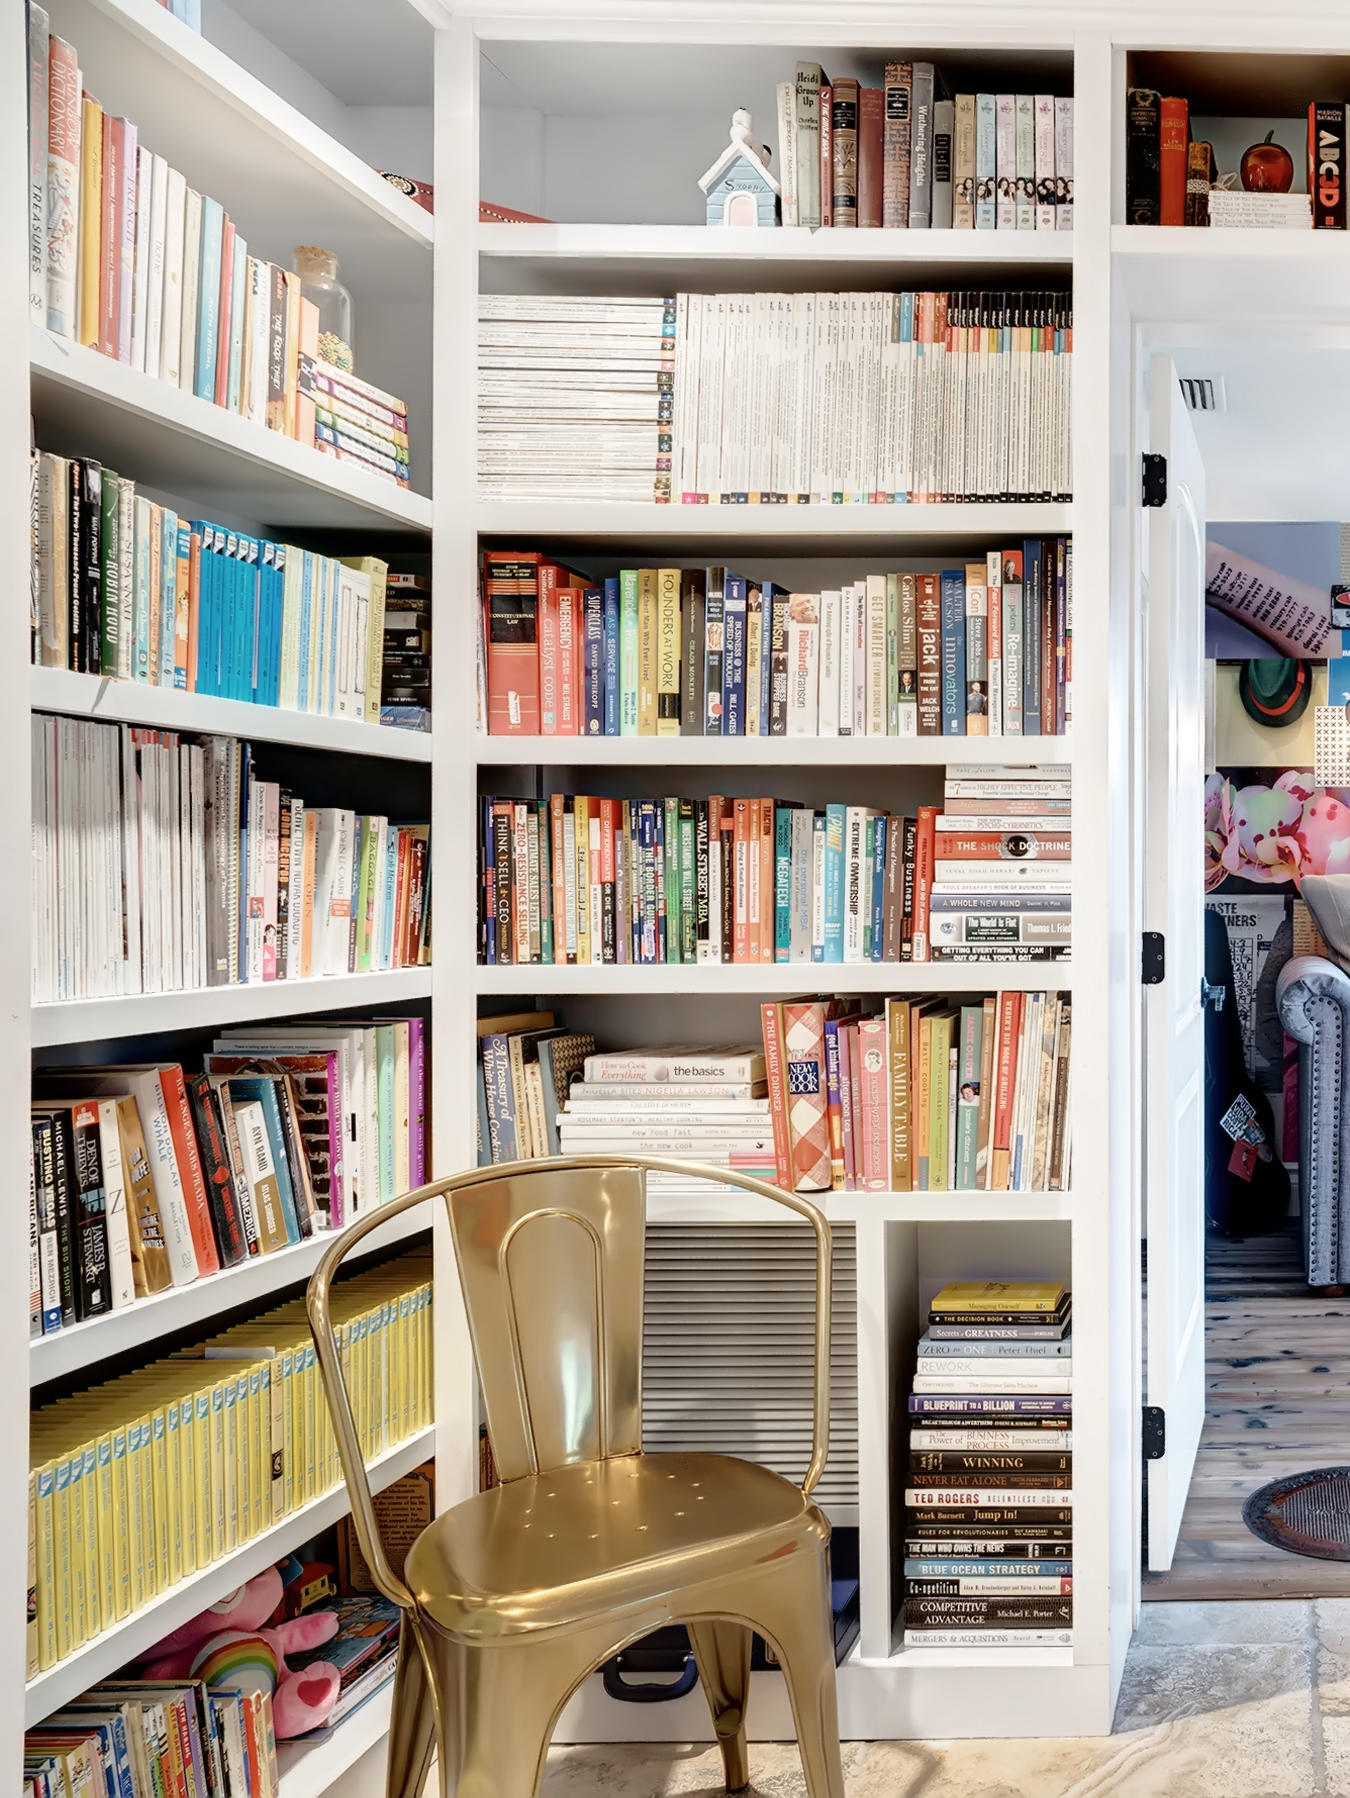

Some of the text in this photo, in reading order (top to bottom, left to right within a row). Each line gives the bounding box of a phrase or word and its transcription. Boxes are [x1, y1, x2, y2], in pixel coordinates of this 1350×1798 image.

[797, 72, 819, 83] Heidi
[797, 86, 819, 96] Grows
[49, 59, 66, 155] DICTIONARY
[64, 67, 77, 147] RAINBOW
[803, 98, 814, 108] Up
[915, 105, 927, 186] Wuthering Heights
[1319, 130, 1340, 208] ABC3D
[31, 184, 42, 274] TREASURES
[125, 177, 136, 244] FRENCH
[271, 314, 283, 333] THE
[272, 335, 285, 362] BOOK
[106, 561, 118, 644] ROBIN HOOD
[902, 575, 915, 644] Carlos Slim
[945, 578, 954, 629] ISAACSON
[954, 578, 963, 622] WALTER
[970, 587, 982, 613] iCon
[990, 587, 1000, 658] Fast Forward MBA
[541, 618, 556, 670] catalyst
[558, 596, 572, 650] EMERGENCY
[662, 574, 675, 687] FOUNDERS AT WORK
[772, 603, 786, 649] BRANSON
[871, 595, 884, 658] GET SMARTER
[974, 618, 983, 656] Steve Jobs
[587, 595, 602, 709] SUPERCLASS DAVID ROTHKOPF
[919, 627, 940, 665] jack
[945, 636, 959, 714] innovators
[1006, 634, 1021, 711] Re-imagine!
[729, 693, 737, 734] BILL GATES
[498, 816, 508, 852] THINK
[763, 806, 771, 836] TRACTION
[827, 812, 842, 853] SPRINT
[280, 809, 290, 883] John McEnroe
[681, 823, 693, 910] UNDERSTANDING WALL STREET
[957, 841, 1070, 850] THE SHOCK DOCTRINE
[385, 851, 395, 900] Leah McLaren
[498, 862, 508, 887] SELL
[516, 822, 528, 945] ZERO-RESISTANCE SELLING
[776, 857, 788, 907] MEGATECH
[798, 849, 808, 931] the personal MBA
[849, 822, 860, 916] EXTREME OWNERSHIP
[904, 826, 916, 912] Funky Business
[499, 899, 509, 923] CEO
[482, 1049, 497, 1083] White
[492, 1039, 512, 1121] A Treasury of
[766, 1019, 780, 1112] THE FAMILY DINNER
[789, 1062, 816, 1074] NEW
[789, 1073, 818, 1084] COOK
[789, 1082, 818, 1092] BOOK
[485, 1085, 499, 1118] House
[893, 1052, 908, 1162] FAMILY TABLE
[1228, 1111, 1244, 1129] COSTA
[1233, 1103, 1247, 1123] VIDA
[1236, 1096, 1253, 1118] PURA
[153, 1116, 167, 1161] WHALE
[154, 1084, 180, 1188] BILLION DOLLAR
[252, 1125, 268, 1172] AYN RAND
[1222, 1118, 1237, 1138] RICA
[42, 1129, 56, 1228] BUSTING VEGAS
[78, 1134, 90, 1187] THIEVES
[86, 1139, 98, 1184] DEN OF
[184, 1130, 205, 1209] WEARS PRADA
[30, 1173, 42, 1248] AMERICANS
[54, 1121, 72, 1297] MICHAEL LEWIS THE BIG SHORT
[241, 1199, 256, 1242] MEZRICH
[261, 1183, 276, 1234] ATLAS SHRUGGED
[83, 1228, 96, 1284] STEWART
[92, 1224, 105, 1257] JAMES
[46, 1236, 57, 1303] BEN MEZRICH
[965, 1329, 1018, 1337] GREATNESS
[921, 1361, 972, 1372] REWORK
[967, 1431, 1010, 1440] BUSINESS
[967, 1441, 1010, 1449] PROCESS
[913, 1475, 1007, 1485] NEVER EAT ALONE
[963, 1458, 1023, 1468] WINNING
[914, 1494, 980, 1504] TED ROGERS
[973, 1510, 1017, 1522] Jump In!
[909, 1582, 958, 1594] Co-opetition
[922, 1565, 1040, 1575] BLUE OCEAN STRATEGY
[920, 1602, 988, 1612] COMPETITIVE
[925, 1616, 985, 1624] ADVANTAGE
[181, 1724, 192, 1759] HARING
